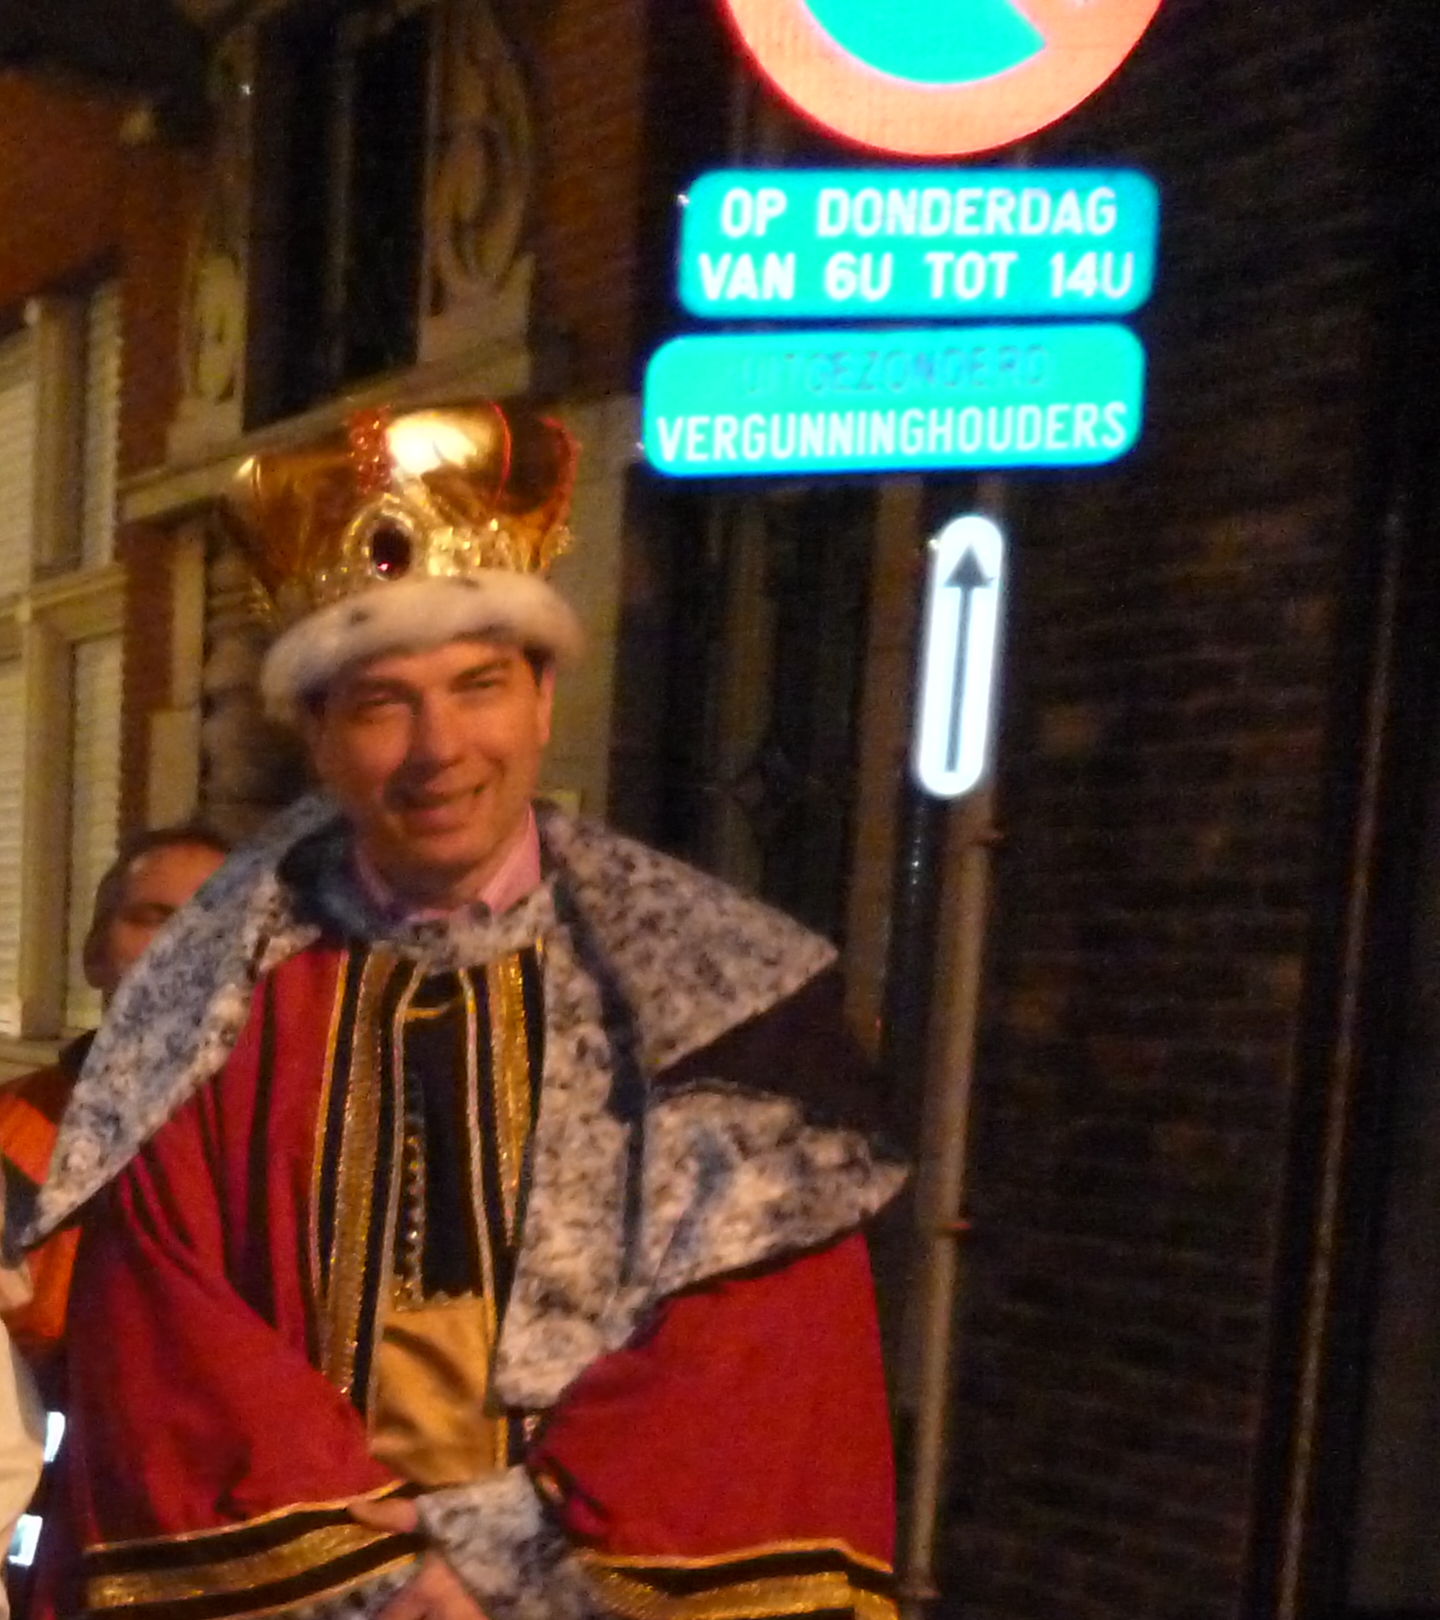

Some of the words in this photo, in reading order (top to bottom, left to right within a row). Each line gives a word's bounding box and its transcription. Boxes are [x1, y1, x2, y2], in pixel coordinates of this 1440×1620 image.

[719, 186, 787, 238] OP
[815, 186, 1118, 238] DONDERDAG
[697, 251, 796, 301] VAN
[823, 251, 894, 301] 6U
[923, 251, 1019, 300] TOT
[1049, 251, 1135, 299] 14U
[655, 401, 1126, 462] VERGUNNINGHOUDERS
